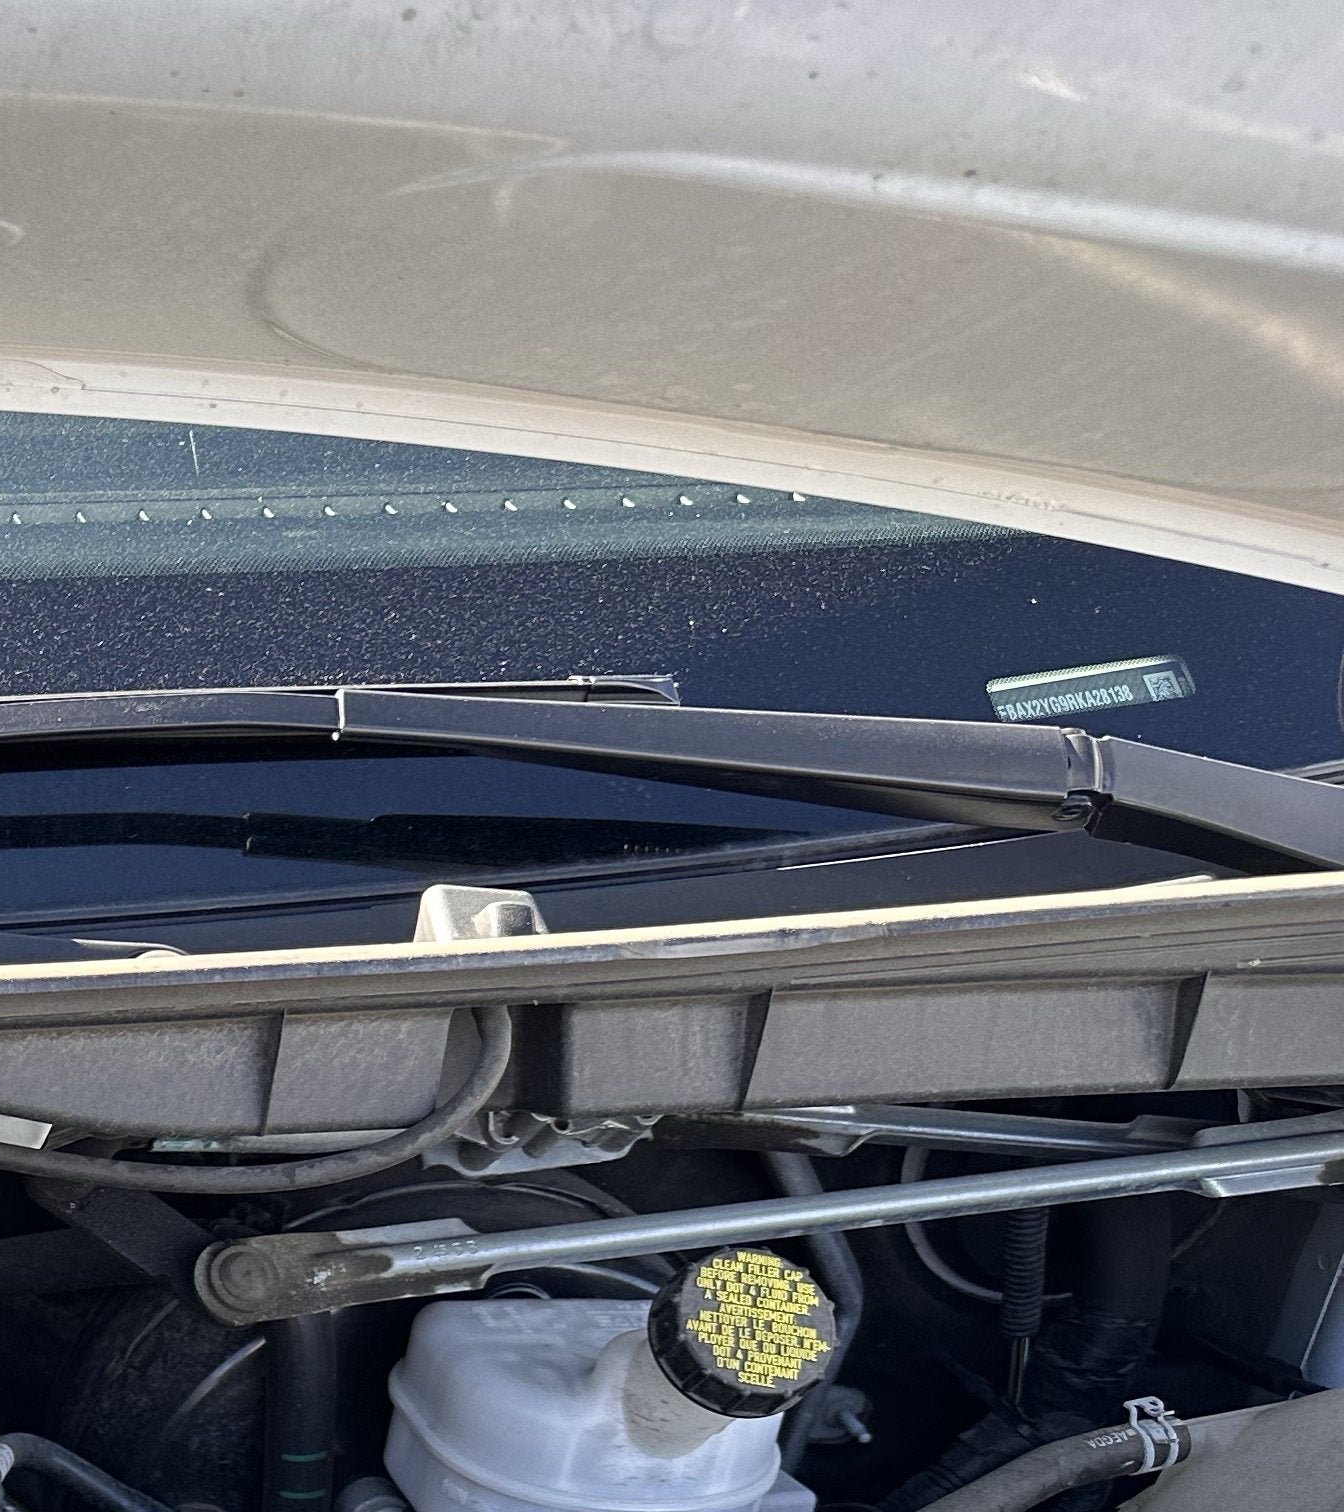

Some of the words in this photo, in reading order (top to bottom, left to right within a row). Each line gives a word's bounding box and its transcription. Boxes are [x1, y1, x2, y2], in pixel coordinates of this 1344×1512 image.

[700, 1266, 737, 1282] BEFORE
[797, 1282, 816, 1296] USE
[712, 1258, 743, 1273] CLEAN
[748, 1263, 780, 1279] FILLER
[784, 1269, 803, 1282] CAP
[696, 1276, 722, 1291] ONLY
[726, 1281, 745, 1295] DOT
[749, 1285, 757, 1296] 4
[760, 1287, 788, 1301] FLUID
[792, 1292, 819, 1307] FROM
[704, 1288, 712, 1300] A
[716, 1291, 752, 1306] SEALED
[686, 1319, 718, 1334] AVANT
[722, 1324, 735, 1337] DE
[738, 1327, 752, 1339] LE
[699, 1310, 748, 1327] NETTOYER
[753, 1319, 766, 1330] LE
[772, 1322, 817, 1340] BOUCHON
[698, 1332, 735, 1348] PLOYER
[739, 1339, 759, 1352] QUE
[762, 1342, 777, 1355] DU
[781, 1345, 818, 1362] LIQUIDE
[712, 1344, 732, 1358] DOT
[747, 1350, 802, 1370] PROVENANT
[744, 1360, 799, 1381] CONTENANT
